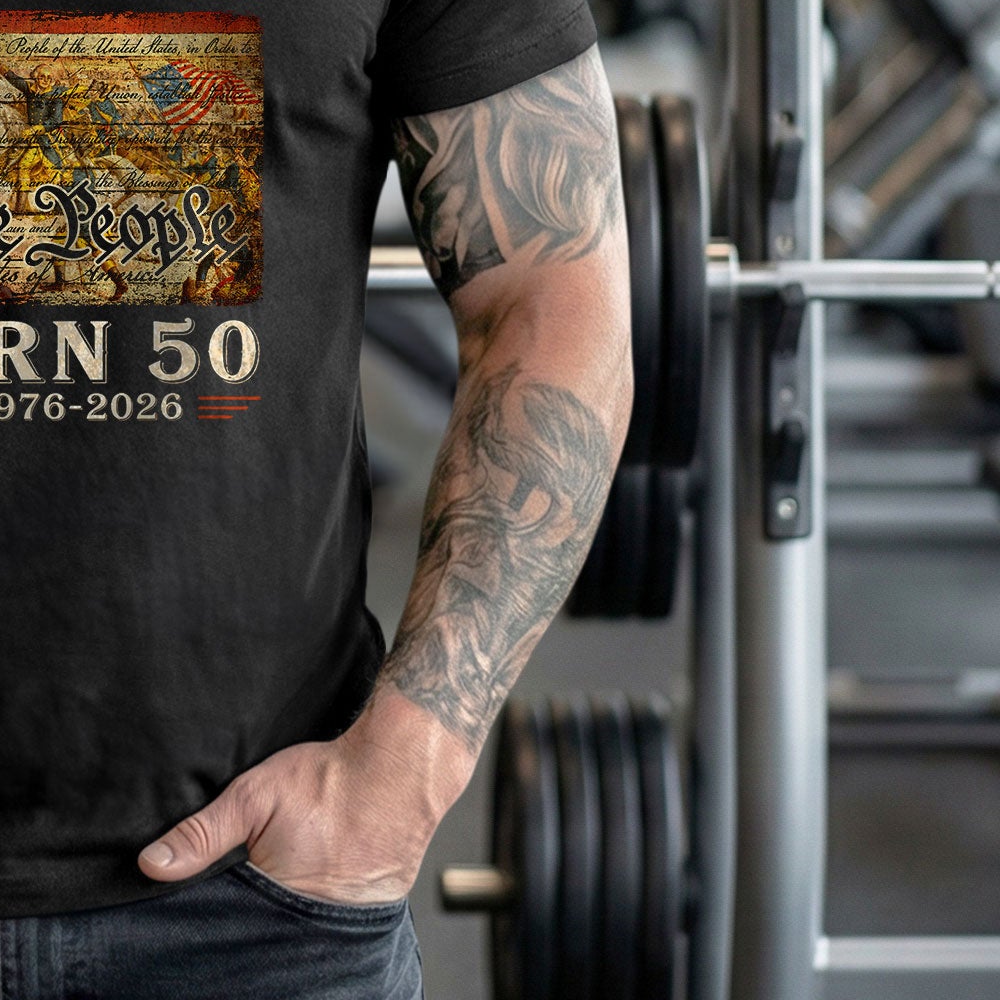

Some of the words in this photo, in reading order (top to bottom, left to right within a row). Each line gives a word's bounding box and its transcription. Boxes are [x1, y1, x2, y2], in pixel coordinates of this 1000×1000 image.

[6, 36, 51, 61] People
[51, 37, 70, 62] of
[68, 36, 87, 54] the
[92, 36, 144, 55] United
[186, 38, 200, 54] in
[117, 170, 180, 191] Blessings
[25, 178, 249, 277] People
[26, 260, 54, 295] of
[147, 317, 260, 385] 50
